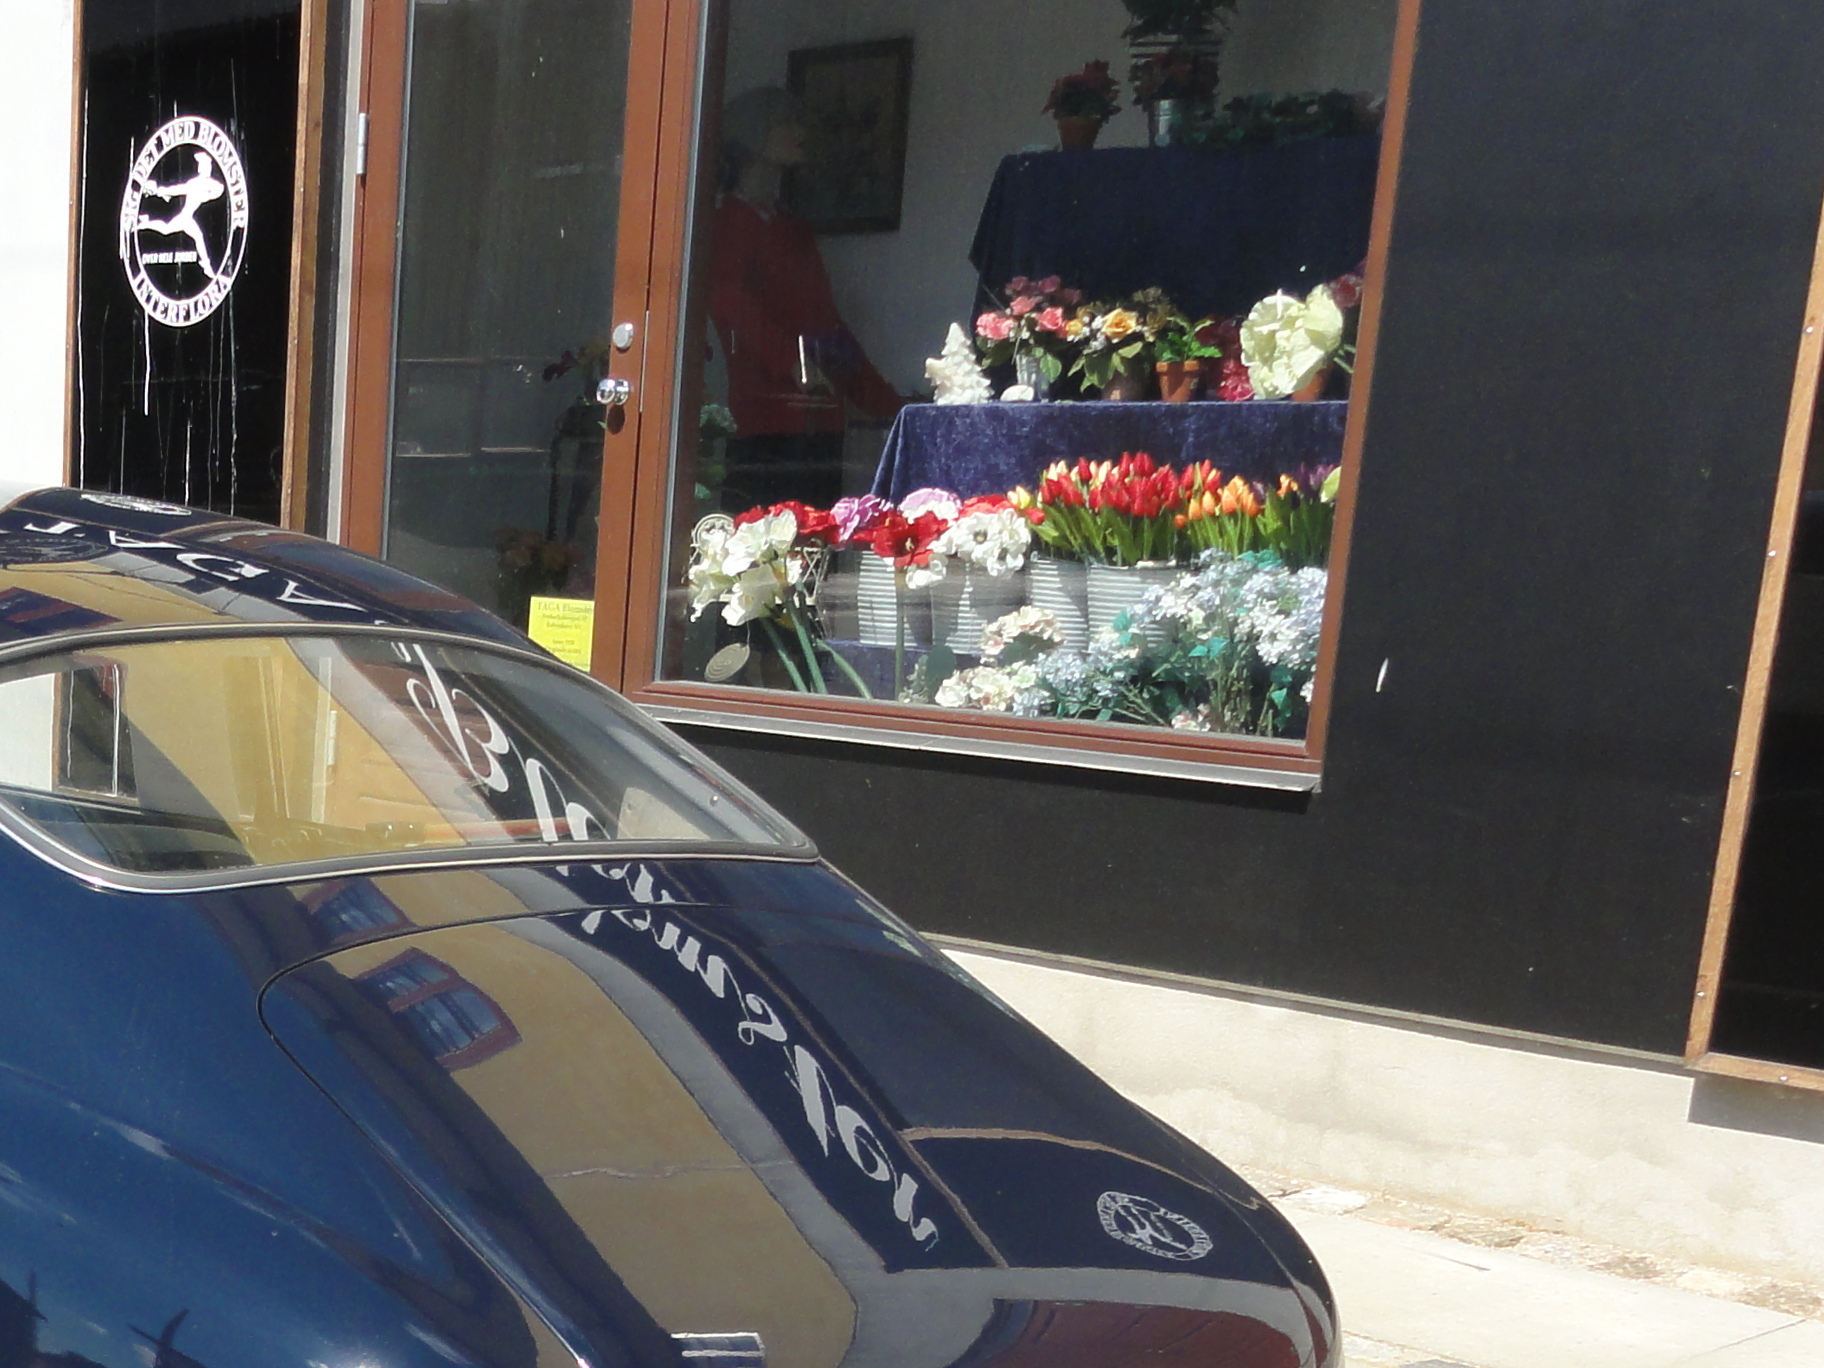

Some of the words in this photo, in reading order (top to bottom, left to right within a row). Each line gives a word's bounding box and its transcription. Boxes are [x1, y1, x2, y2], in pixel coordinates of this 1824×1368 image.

[133, 140, 164, 184] DET
[161, 121, 195, 147] MED
[198, 121, 246, 229] BLOMSTER
[133, 272, 231, 324] INTERFLORA
